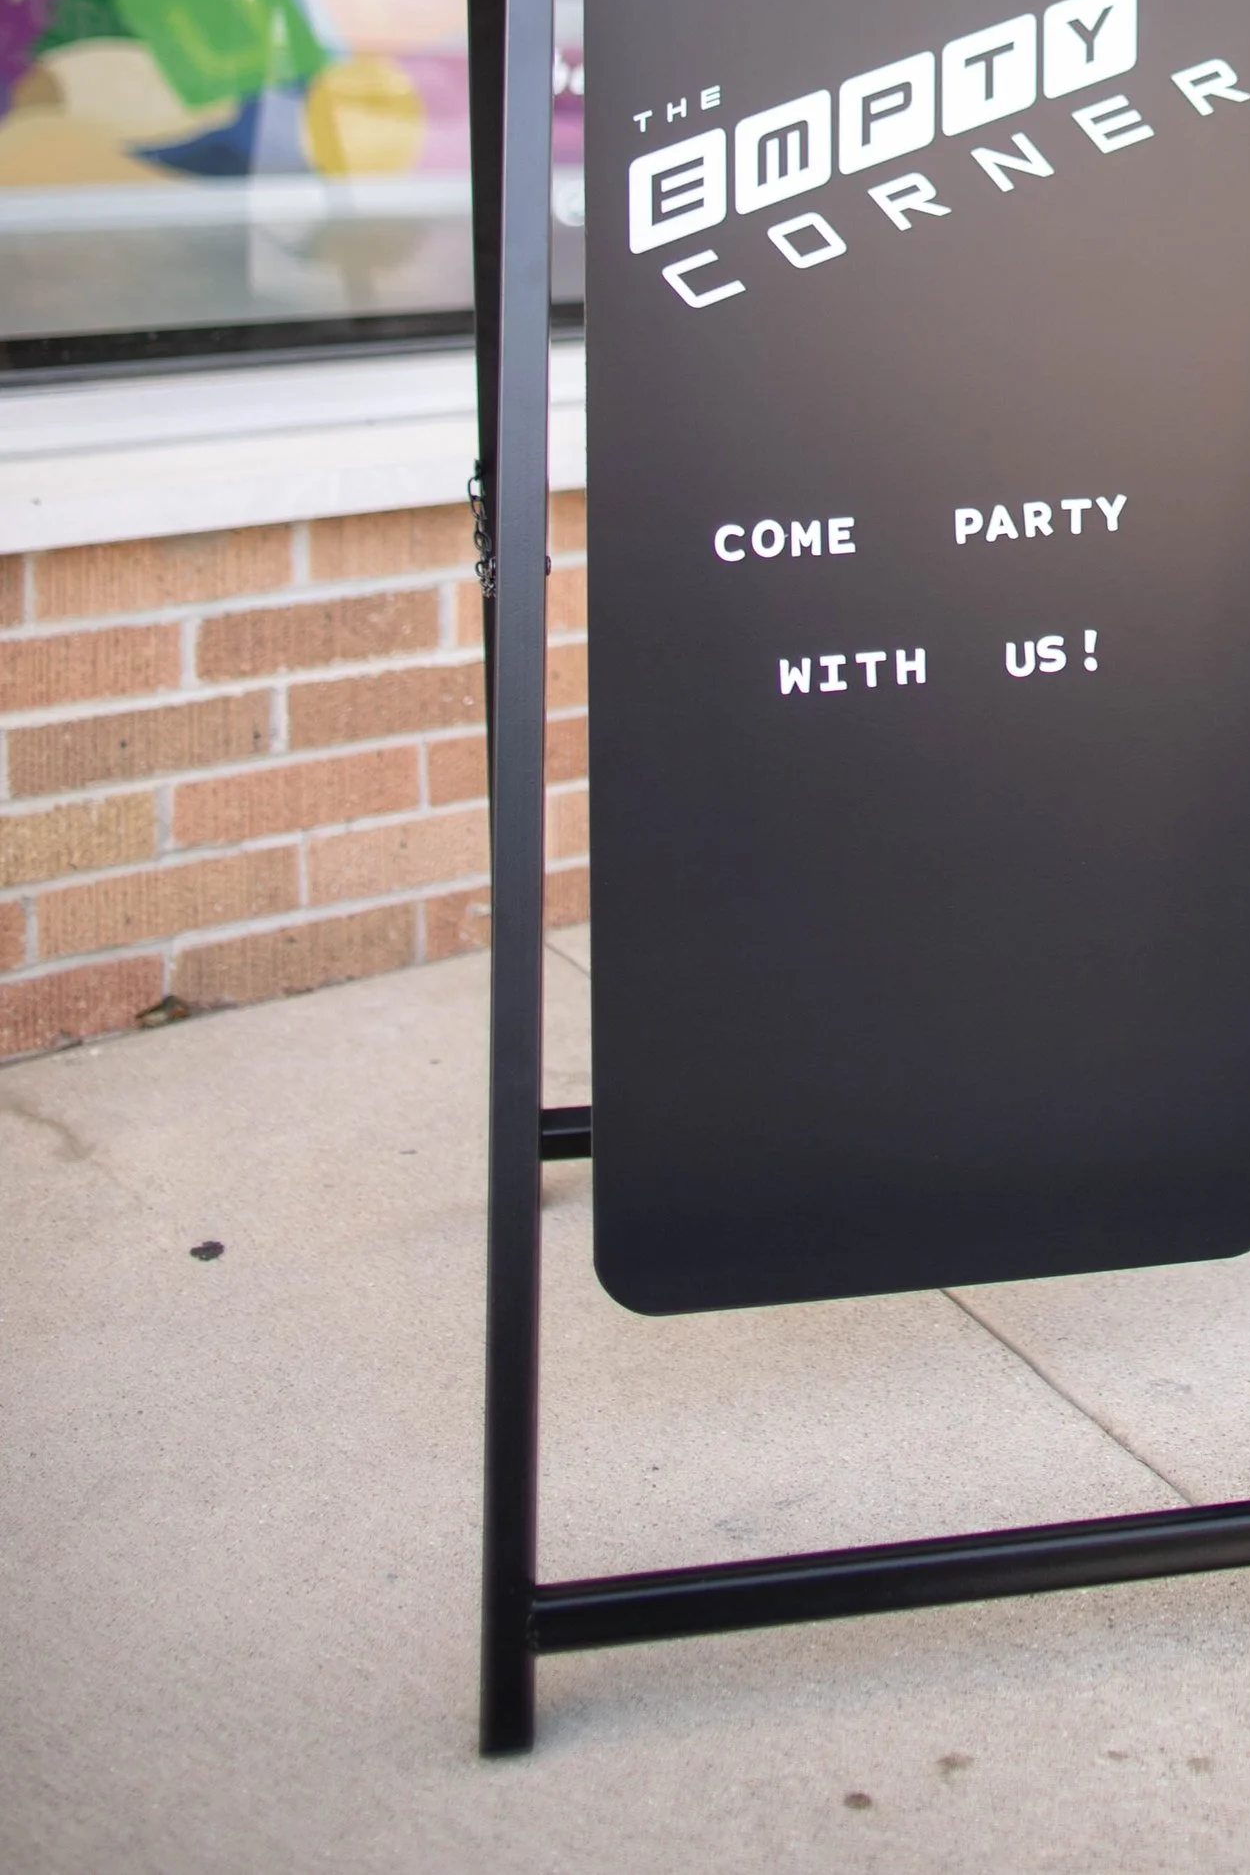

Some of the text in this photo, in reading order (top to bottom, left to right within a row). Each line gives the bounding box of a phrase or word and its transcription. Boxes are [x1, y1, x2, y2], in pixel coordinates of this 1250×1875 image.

[632, 85, 721, 133] THE
[714, 494, 1127, 562] COME PARTY
[779, 629, 1098, 695] WITH US!
